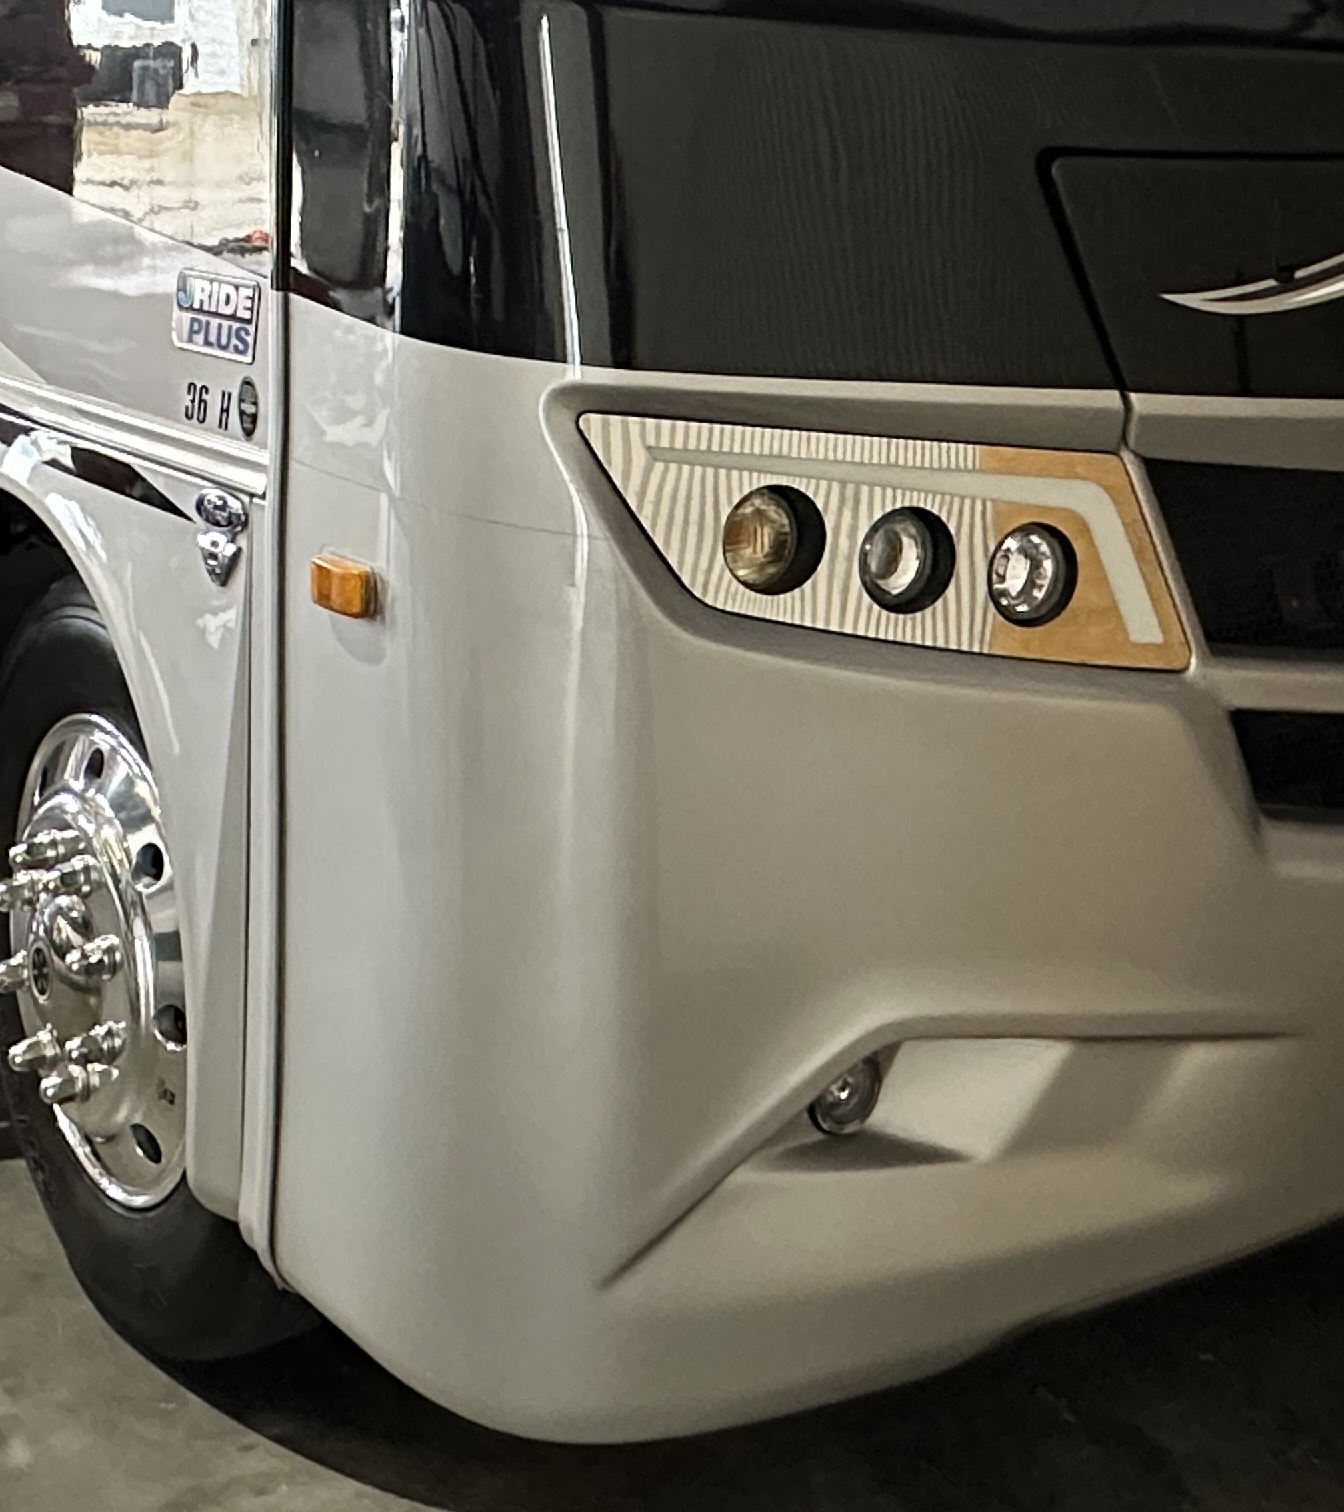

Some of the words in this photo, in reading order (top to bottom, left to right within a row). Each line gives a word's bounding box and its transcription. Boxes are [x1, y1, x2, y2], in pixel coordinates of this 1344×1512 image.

[177, 276, 254, 320] JRIDE
[188, 316, 251, 356] PLUS
[184, 381, 209, 424] 36
[218, 389, 232, 431] H
